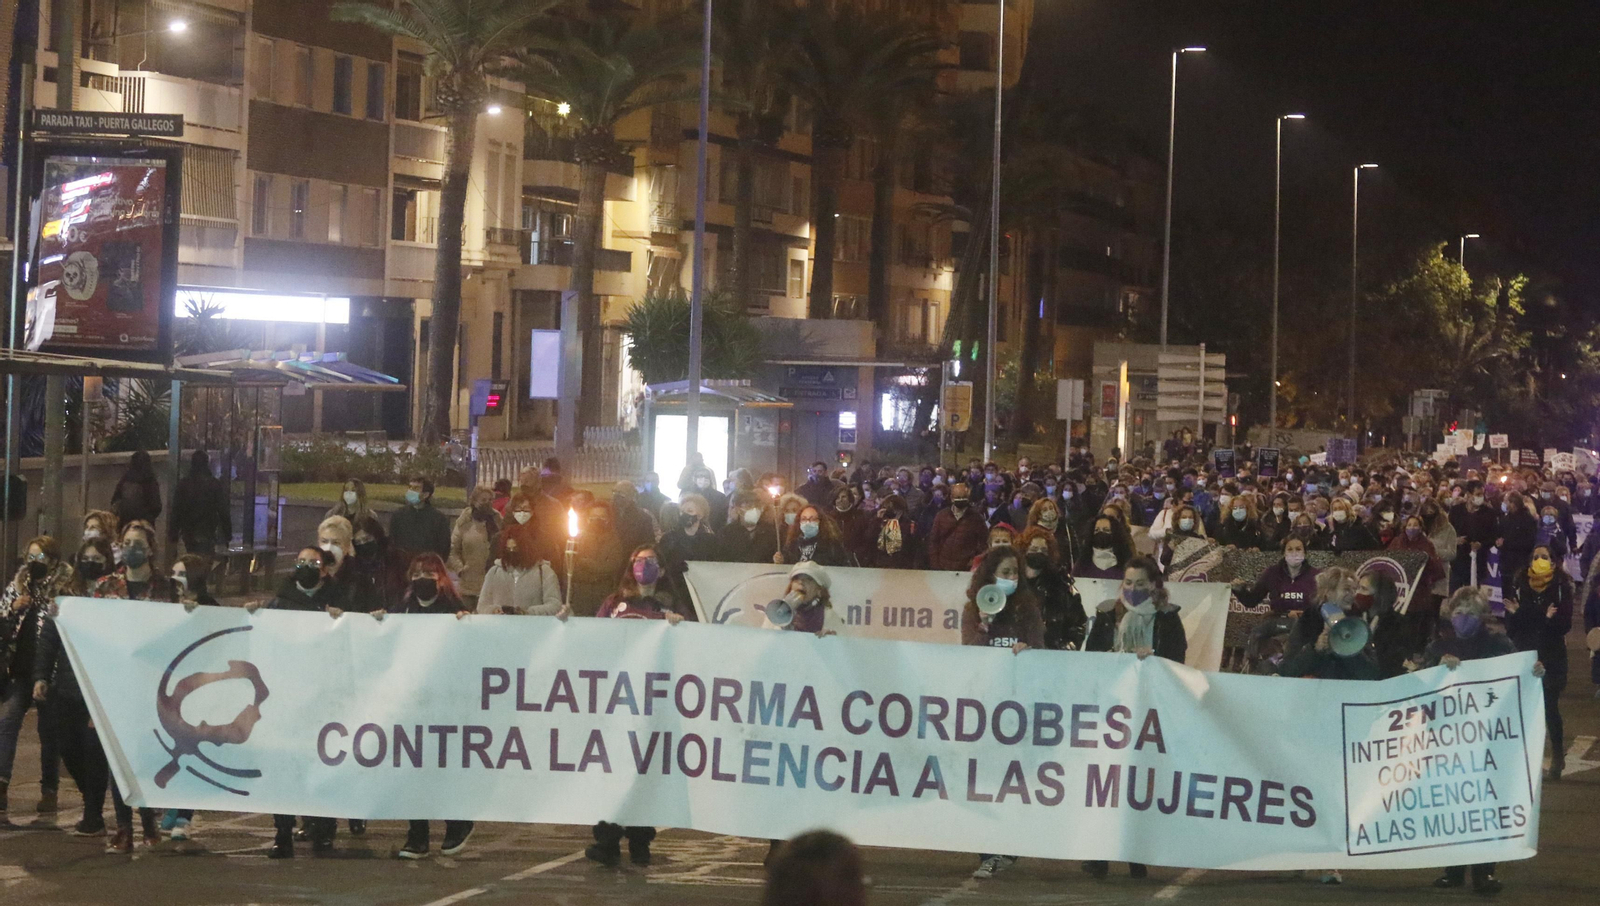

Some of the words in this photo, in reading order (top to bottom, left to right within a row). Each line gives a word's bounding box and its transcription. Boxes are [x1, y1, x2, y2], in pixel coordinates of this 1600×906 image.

[41, 114, 74, 127] PARADA
[75, 115, 93, 128] TAXI
[99, 117, 130, 130] PUERTA
[131, 118, 175, 132] GALLEGOS
[951, 413, 960, 427] P
[847, 599, 872, 626] ni
[883, 606, 933, 629] una
[943, 608, 960, 630] a
[482, 667, 825, 731] PLATAFORMA
[840, 690, 1167, 754] CORDOBESA
[1443, 688, 1479, 718] DÍA
[1351, 717, 1519, 764] INTERNACIONAL
[317, 721, 532, 771] CONTRA
[548, 728, 611, 773] LA
[628, 731, 900, 797] VIOLENCIA
[913, 754, 949, 800] A
[967, 758, 1066, 806] LAS
[1085, 763, 1318, 828] MUJERES
[1378, 752, 1465, 787] CONTRA
[1471, 749, 1498, 772] LA
[1382, 777, 1498, 814] VIOLENCIA
[1356, 823, 1371, 847] A
[1376, 818, 1417, 844] LAS
[1424, 804, 1527, 839] MUJERES
